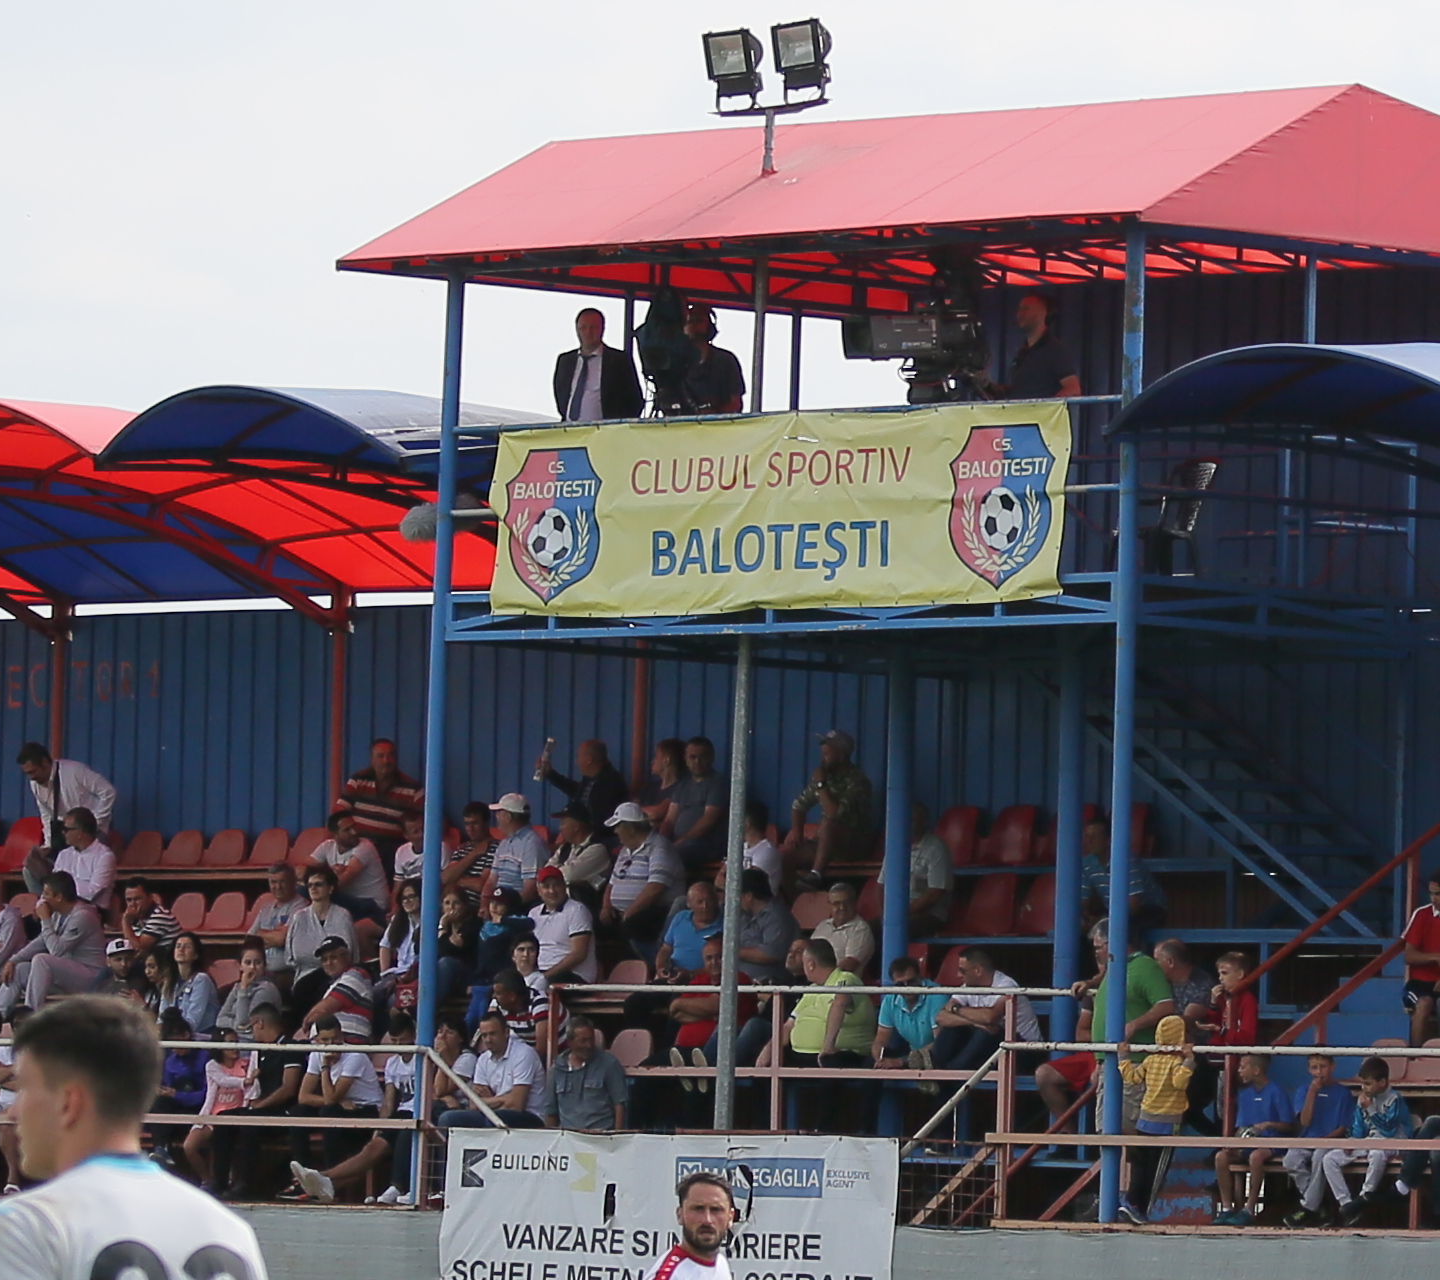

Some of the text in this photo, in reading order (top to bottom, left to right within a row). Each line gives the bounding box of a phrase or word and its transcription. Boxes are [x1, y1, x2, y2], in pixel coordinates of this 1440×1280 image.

[631, 446, 911, 495] CLUBUL SPORTIV
[958, 457, 1048, 479] BALOTESTI
[512, 479, 596, 500] BALOTESTI
[491, 1152, 570, 1172] BUILDING
[825, 1169, 871, 1181] EXCLUSIVE
[825, 1179, 856, 1189] AGENT
[502, 1223, 625, 1254] VANZARE
[632, 1230, 658, 1257] SI
